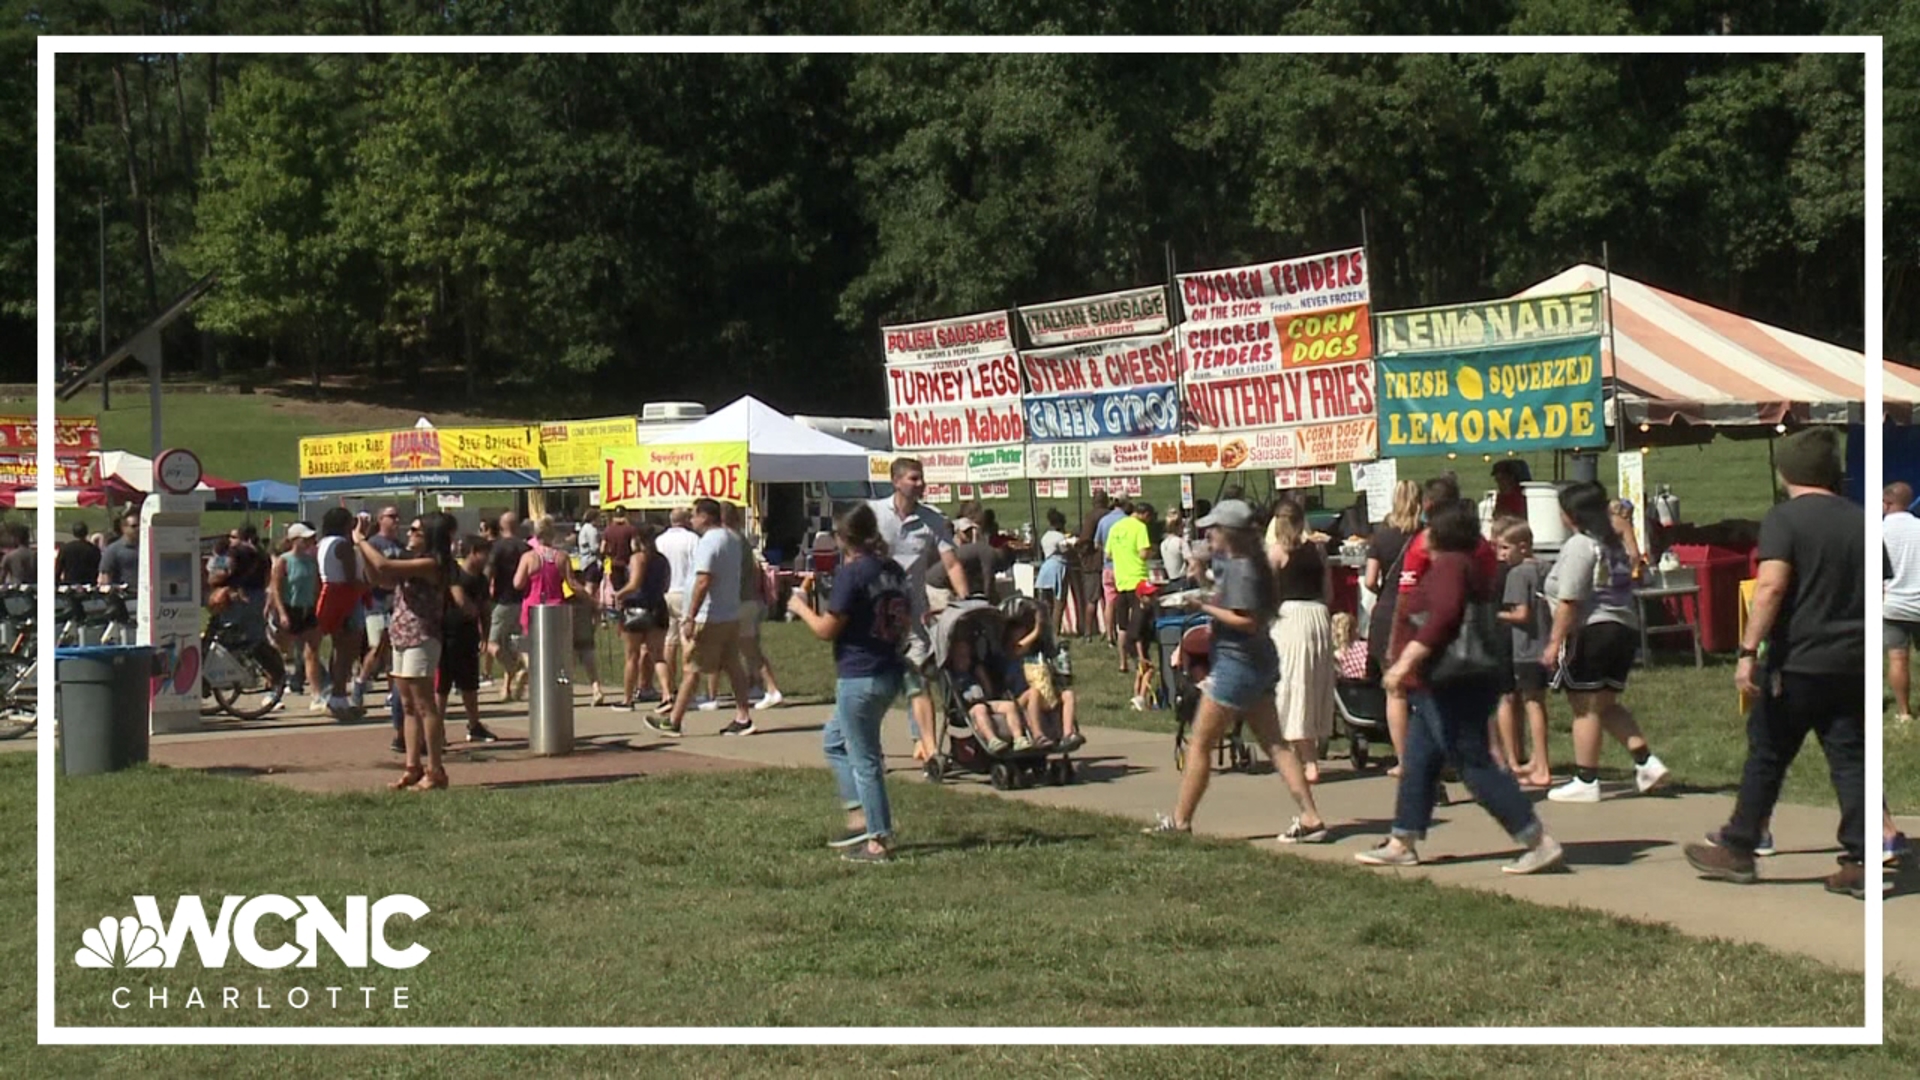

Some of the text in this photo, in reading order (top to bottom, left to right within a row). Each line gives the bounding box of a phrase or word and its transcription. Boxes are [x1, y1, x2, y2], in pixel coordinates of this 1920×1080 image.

[1184, 251, 1363, 306] CHICKEN TENDERS
[1192, 301, 1262, 321] ON THE STICK
[1300, 296, 1328, 309] NEVER
[1330, 290, 1367, 303] FROZEN!
[1026, 297, 1163, 334] ITALIAN SAUSAGE
[1288, 311, 1356, 339] CORN
[888, 319, 1006, 353] POLISH SAUSAGE
[1188, 320, 1270, 348] CHICKEN
[1193, 342, 1273, 370] TENDERS
[1292, 334, 1359, 363] DOGS
[933, 359, 968, 370] JUMBO
[1025, 340, 1177, 395] STEAK & CHEESE
[890, 354, 1020, 406] TURKEY LEGS
[1385, 355, 1593, 399] FRESH SQUEEZED
[1186, 363, 1373, 427] BUTTERFLY FRIES
[894, 404, 1022, 446] Chicken Kabob
[1030, 389, 1178, 438] GREEK GYROS
[1387, 402, 1595, 445] LEMONADE
[1256, 433, 1289, 447] Italian
[1306, 421, 1365, 442] CORN DOGS
[303, 438, 384, 456] PULLED PORK RIBS
[1051, 445, 1081, 456] GREEK
[1113, 443, 1138, 454] Steak
[1179, 440, 1218, 467] Sausage
[1250, 447, 1293, 461] Sausage
[1312, 437, 1359, 453] CORN DOGS
[1316, 449, 1354, 462] CORN DOGS
[308, 460, 351, 474] BARBEQUE
[491, 455, 530, 469] CHICKEN
[1051, 457, 1082, 468] GYROS
[1115, 454, 1148, 463] Cheese
[606, 459, 741, 503] LEMONADE
[155, 606, 179, 619] joy
